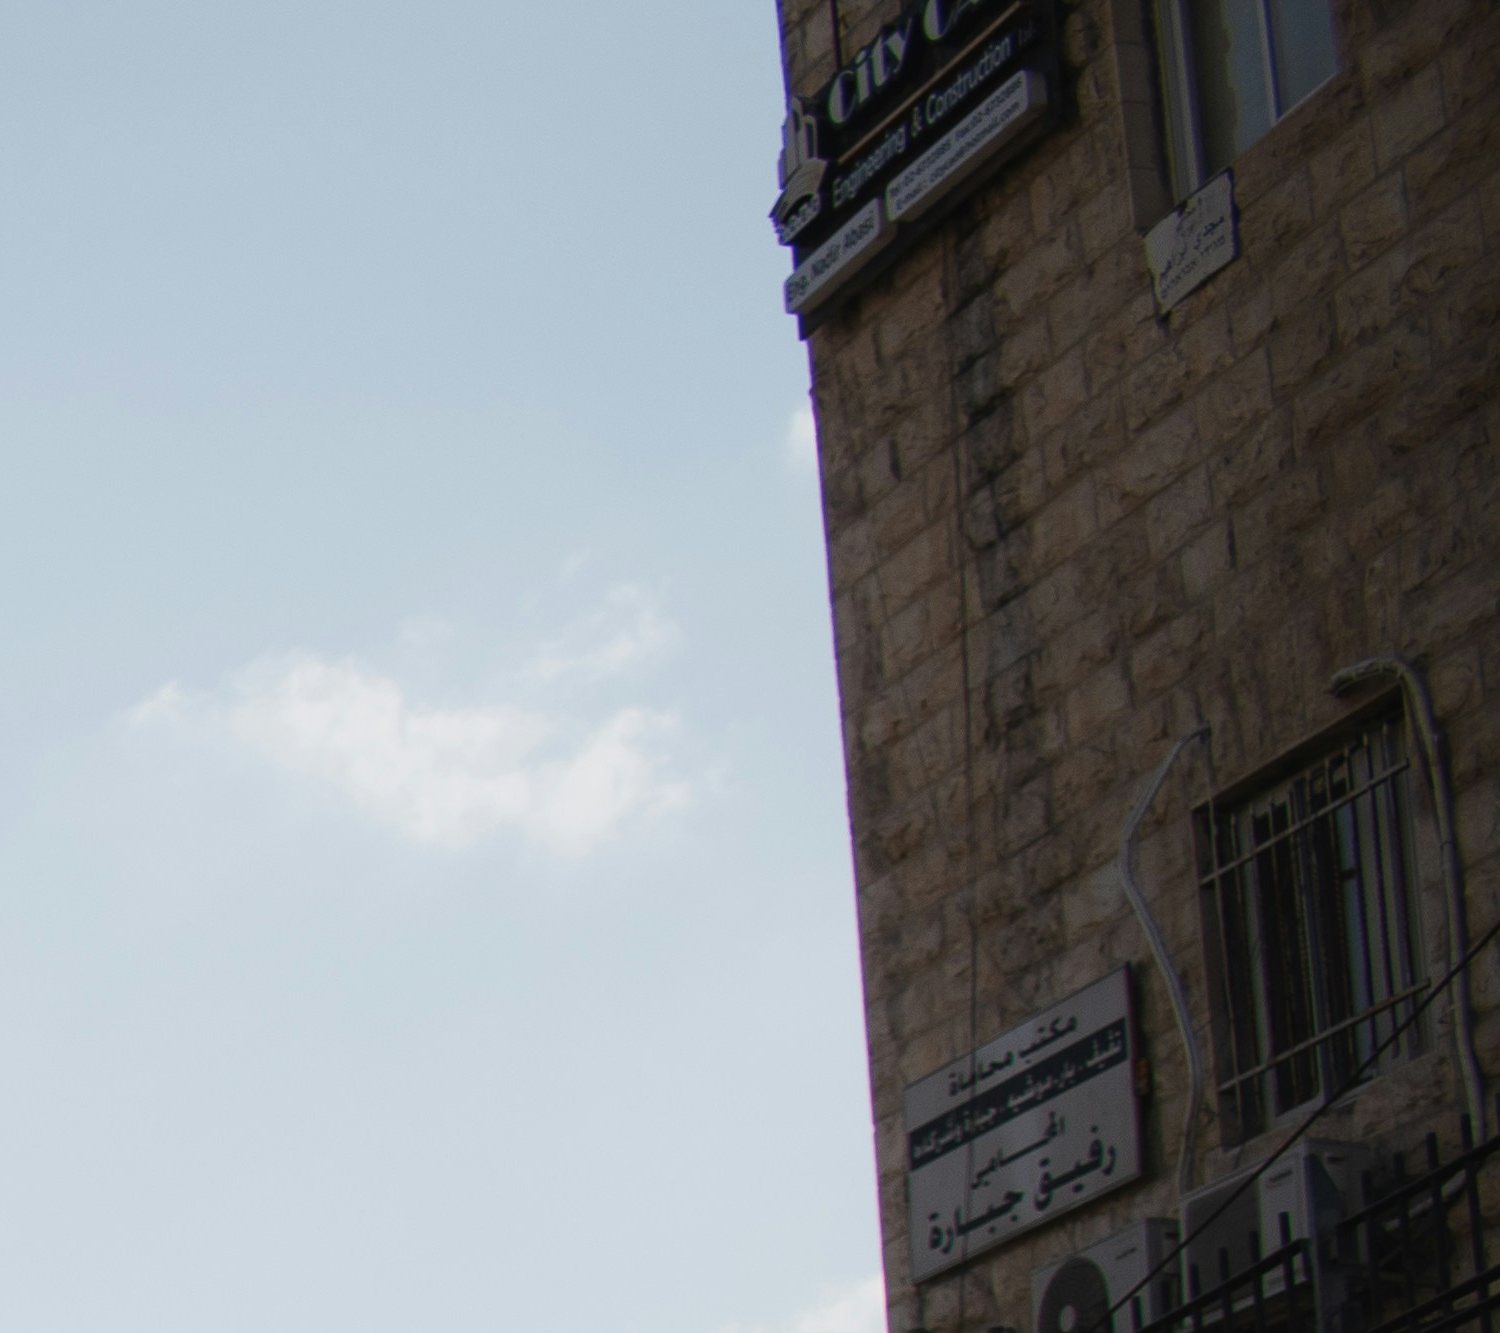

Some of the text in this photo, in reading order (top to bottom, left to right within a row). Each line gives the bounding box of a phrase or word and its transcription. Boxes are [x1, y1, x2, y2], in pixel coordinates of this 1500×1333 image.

[833, 123, 907, 208] Engineering
[925, 34, 1013, 126] Construction
[949, 1016, 1078, 1097] مكتب محاماة
[928, 1124, 1116, 1254] رفيق جبارة
